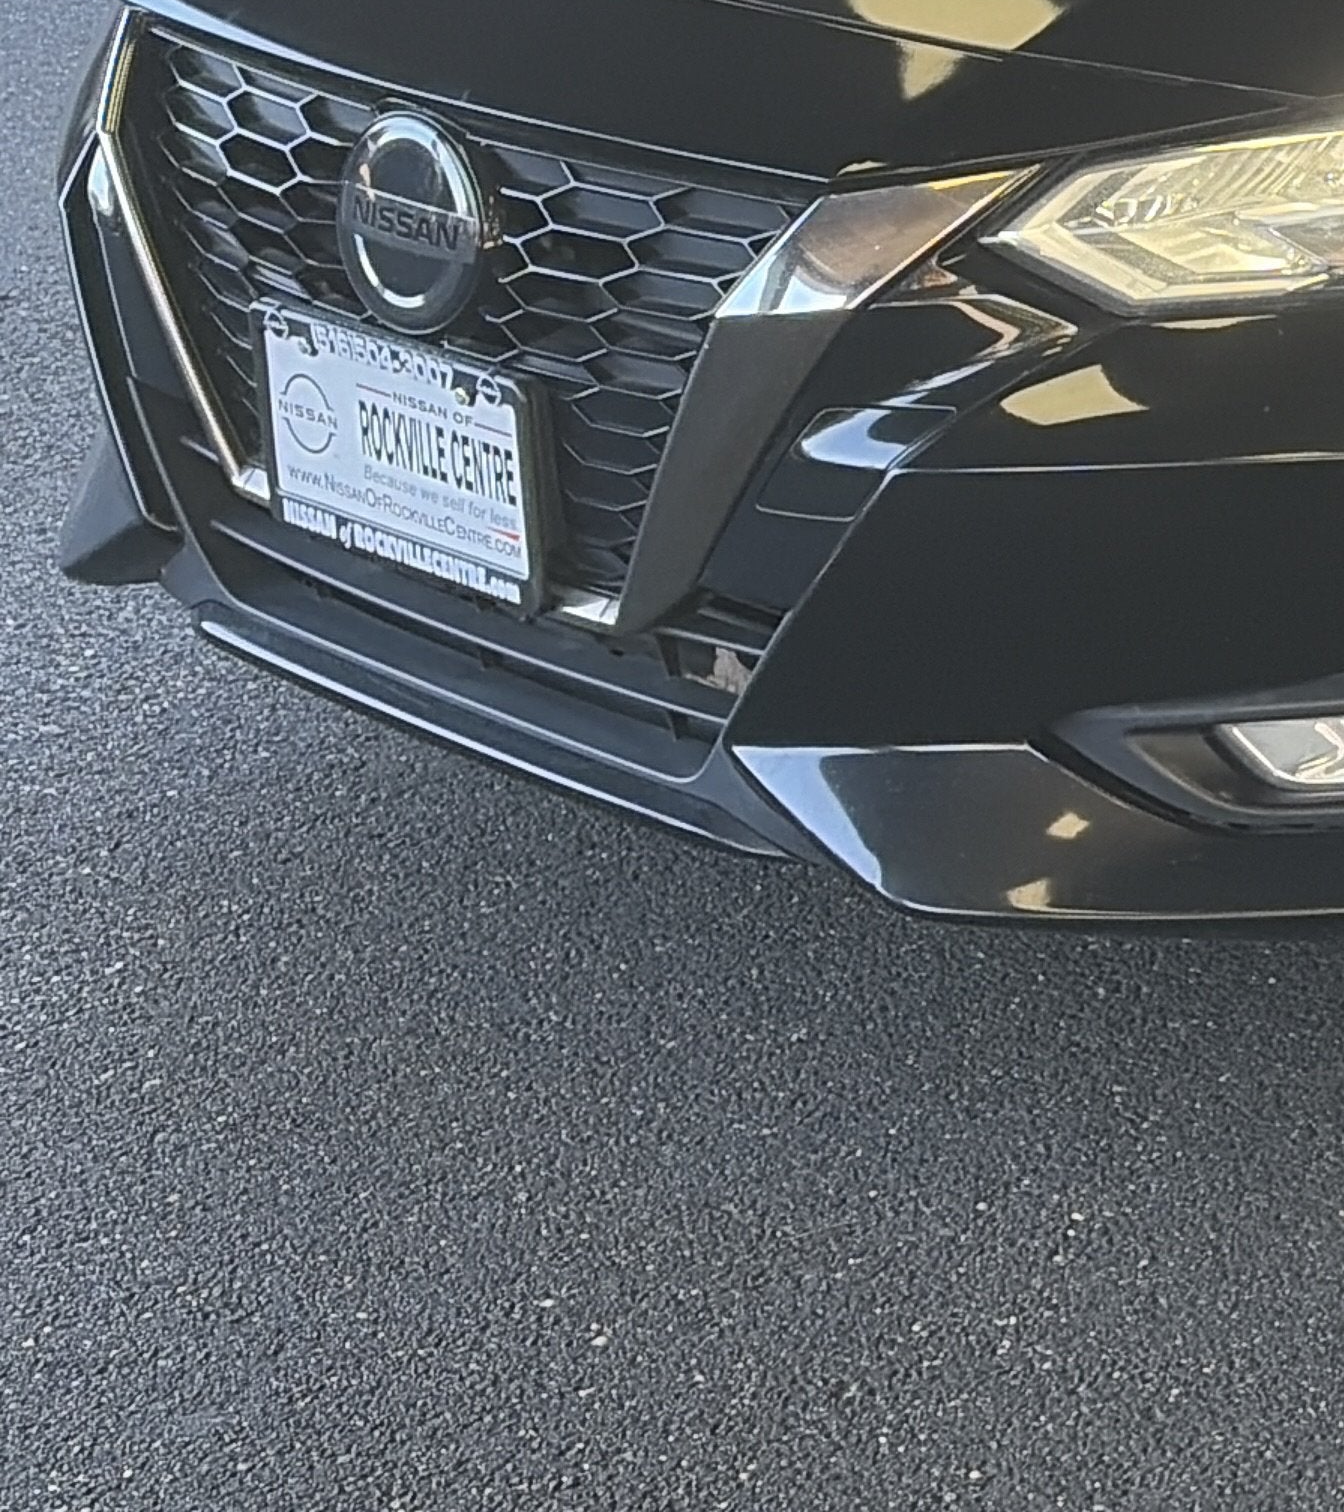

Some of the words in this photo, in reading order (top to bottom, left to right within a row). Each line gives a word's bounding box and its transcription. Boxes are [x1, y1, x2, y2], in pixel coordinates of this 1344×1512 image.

[353, 195, 460, 250] NISSAN
[278, 399, 338, 428] NISSAN
[392, 392, 448, 419] NISSAN
[453, 411, 473, 426] OF
[358, 400, 448, 483] ROCKVILLE
[451, 430, 517, 506] CENTRE
[282, 498, 337, 539] NISSAN
[339, 522, 352, 549] of
[364, 464, 418, 495] Because
[420, 489, 440, 503] we
[443, 495, 465, 512] sell
[468, 501, 486, 519] for
[490, 508, 517, 530] less
